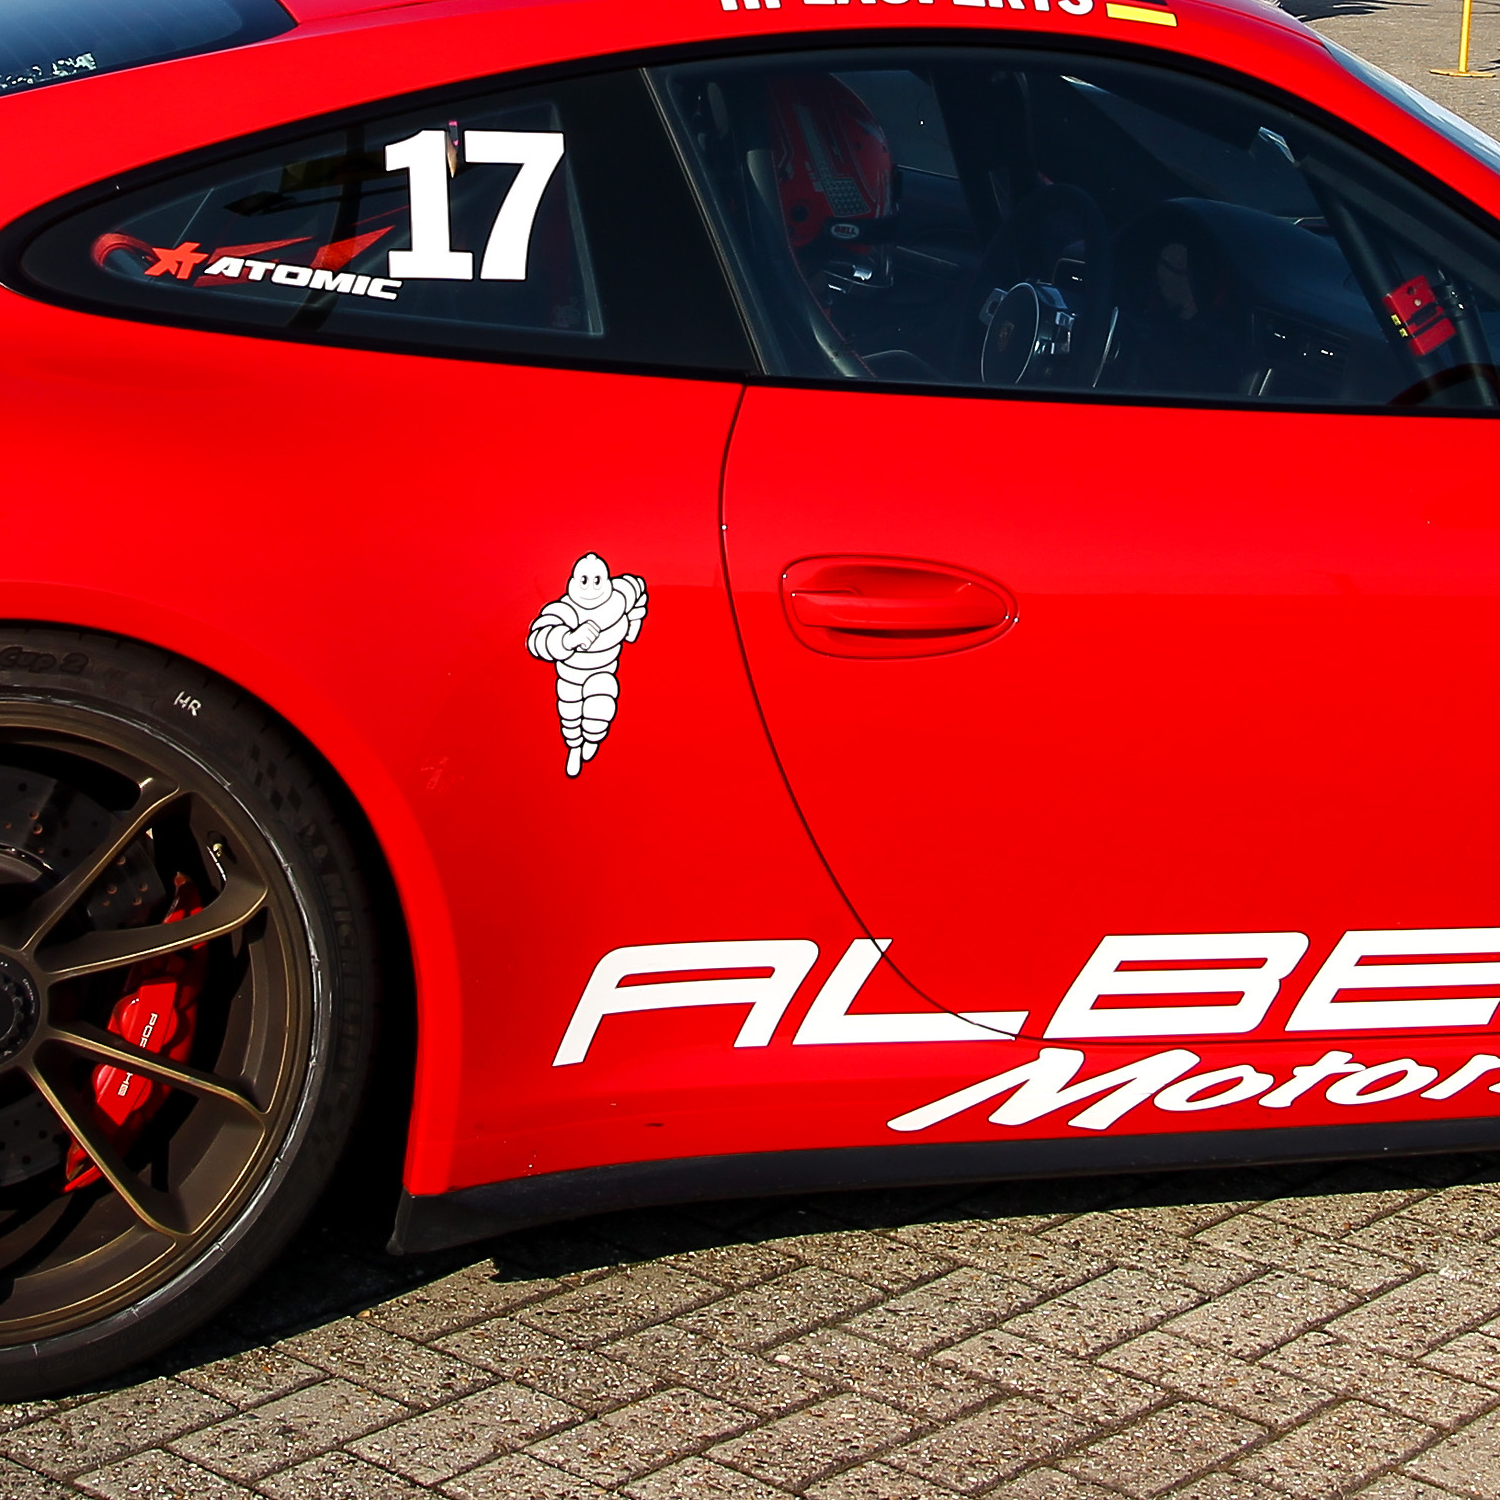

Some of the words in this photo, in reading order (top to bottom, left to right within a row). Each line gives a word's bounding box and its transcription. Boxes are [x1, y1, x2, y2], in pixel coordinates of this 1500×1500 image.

[384, 129, 566, 281] 17
[204, 257, 404, 301] ATOMIC
[60, 652, 89, 675] 2
[117, 1012, 159, 1097] PORHE
